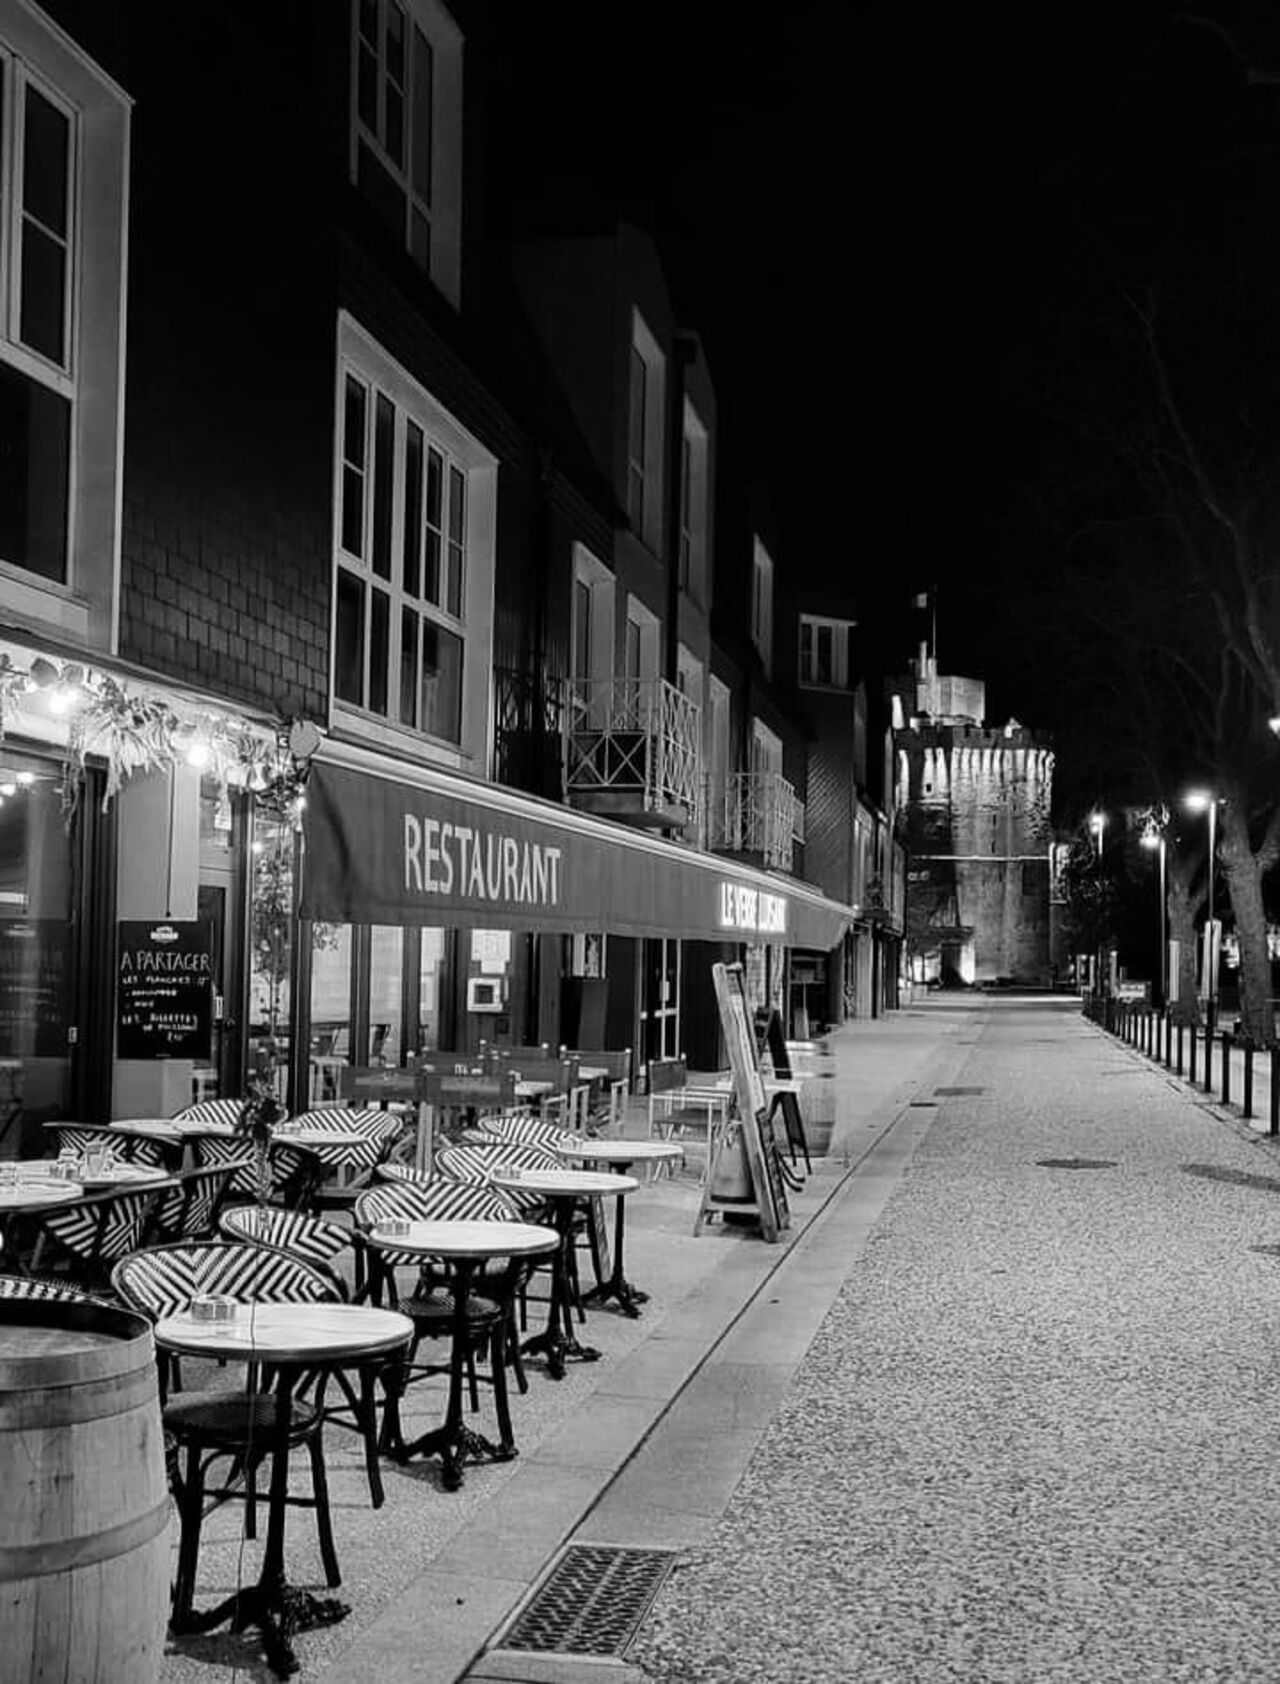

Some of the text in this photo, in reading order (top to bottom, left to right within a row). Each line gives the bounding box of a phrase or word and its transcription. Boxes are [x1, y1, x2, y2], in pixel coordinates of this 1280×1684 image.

[404, 813, 561, 905] RESTAURANT
[721, 881, 736, 926] LE
[120, 950, 212, 973] A PARTAGER
